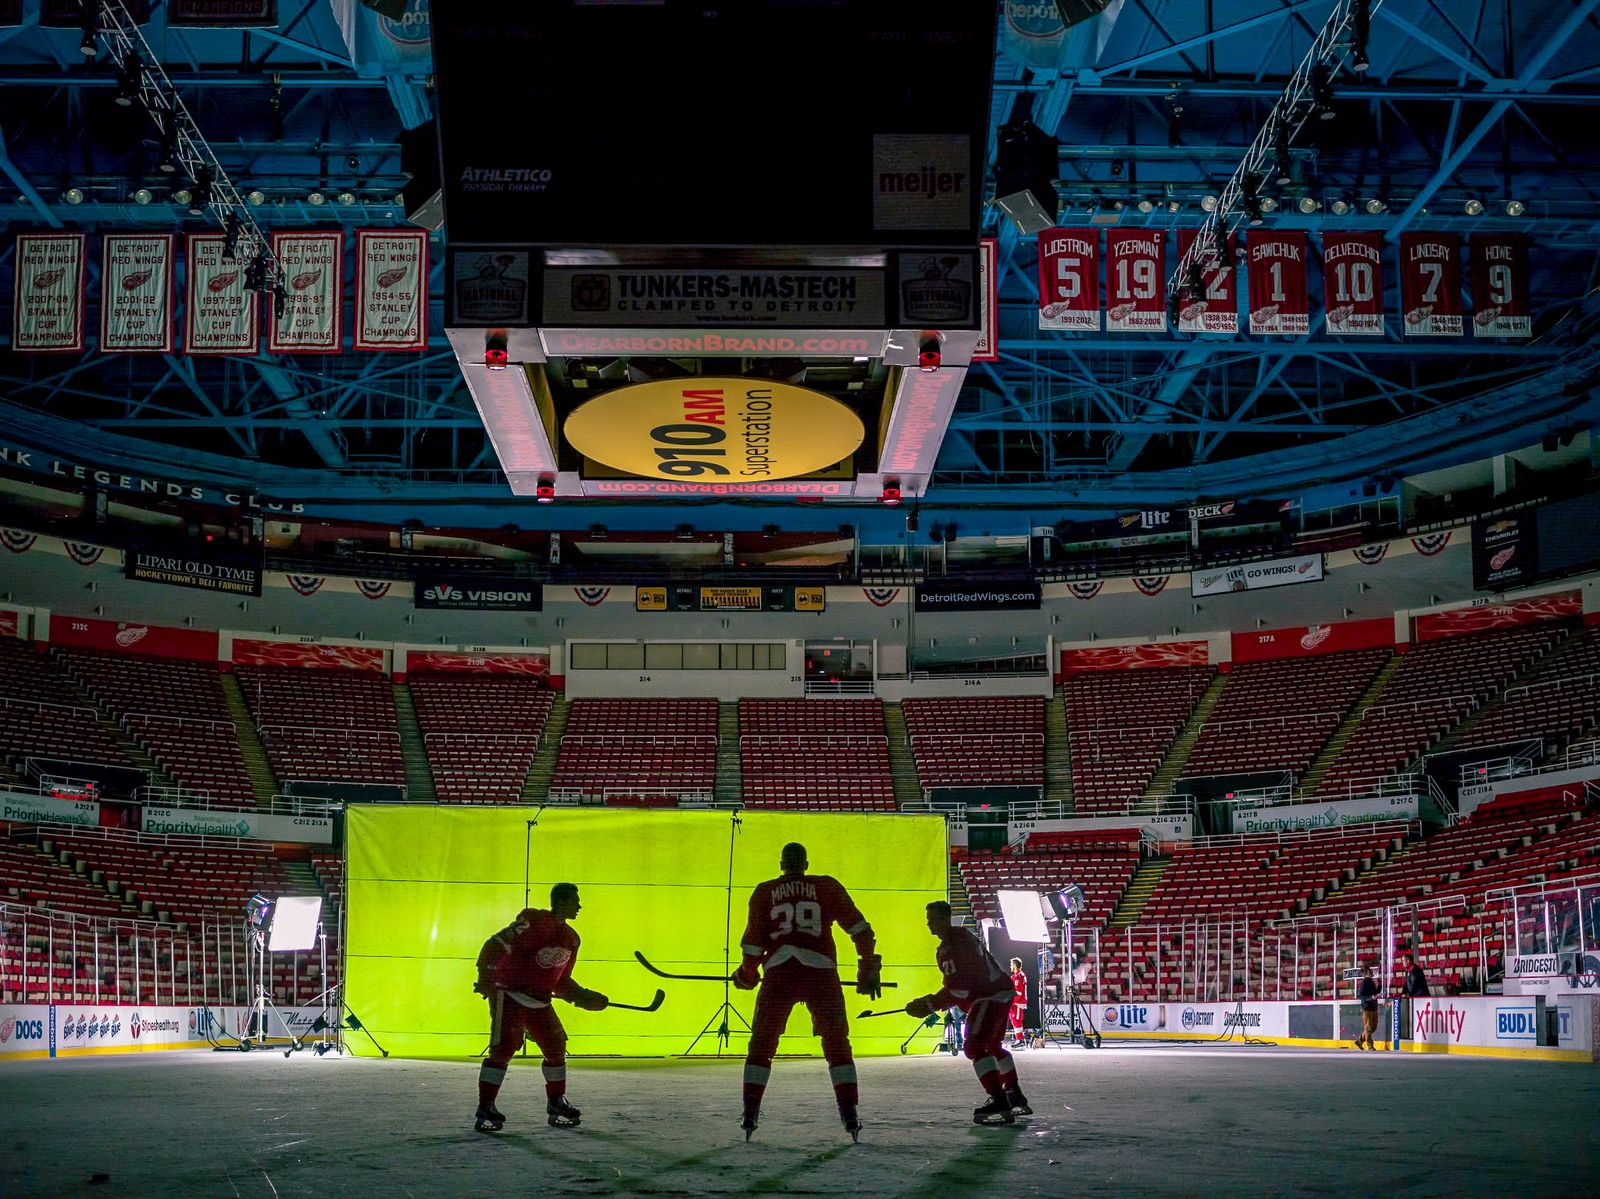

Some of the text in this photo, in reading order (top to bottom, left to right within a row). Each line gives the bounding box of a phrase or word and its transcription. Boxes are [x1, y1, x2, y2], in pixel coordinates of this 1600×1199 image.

[460, 166, 552, 182] ATHLETICO
[880, 166, 965, 199] meijer
[1154, 233, 1160, 243] C
[30, 244, 72, 253] DETROIT
[117, 244, 160, 253] DETROIT
[287, 244, 328, 253] DETROIT
[372, 242, 414, 250] DETROIT
[1044, 239, 1093, 258] LIDSTROM
[1114, 239, 1159, 259] YZERMAN
[1252, 242, 1300, 262] SAWCHUK
[25, 256, 75, 264] RED WINGS
[111, 256, 163, 265] RED WINGS
[282, 256, 333, 264] RED WINGS
[367, 253, 417, 262] RED WINGS
[1324, 242, 1380, 265] DELVECCHIO
[1410, 246, 1450, 262] LINDSAY
[1485, 245, 1513, 262] HOWE
[197, 258, 215, 266] RED
[1058, 257, 1081, 297] 5
[1116, 259, 1156, 299] 19
[1269, 262, 1286, 302] 1
[1335, 263, 1373, 302] 10
[1419, 263, 1442, 303] 7
[1489, 264, 1511, 304] 9
[618, 275, 856, 299] TUNKERS-MASTECH
[28, 295, 68, 304] 2007-08
[117, 295, 156, 304] 2001-02
[202, 296, 242, 305] 1997-98
[372, 292, 411, 300] 1954-55
[27, 307, 68, 317] STANLEY
[114, 309, 157, 317] STANLEY
[200, 308, 243, 317] STANLEY
[285, 306, 326, 315] STANLEY
[369, 304, 412, 312] STANLEY
[618, 301, 856, 313] CLAMPED TO DETROIT
[38, 320, 57, 329] CUP
[126, 321, 145, 329] CUP
[212, 321, 231, 329] CUP
[295, 319, 315, 327] CUP
[381, 316, 401, 325] CUP
[20, 332, 73, 342] CHAMPIONS
[109, 333, 162, 342] CHAMPIONS
[195, 333, 248, 342] CHAMPIONS
[278, 331, 331, 340] CHAMPIONS
[364, 328, 417, 337] CHAMPIONS
[650, 389, 729, 475] 910 AM
[738, 389, 777, 476] Superstation
[52, 460, 203, 500] LEGENDS
[1188, 505, 1221, 519] DECK
[1140, 510, 1170, 529] Lite
[136, 553, 255, 582] LIPARI OLD TYME
[1248, 569, 1262, 578] GO
[1263, 564, 1296, 576] WINGS!
[467, 591, 532, 602] VISION
[920, 591, 1035, 603] DetroitRedWings.com
[1258, 635, 1275, 643] 217A
[1246, 812, 1326, 832] PriorityHealth
[771, 881, 817, 906] MANTHA
[769, 900, 823, 941] 39
[1119, 1005, 1148, 1028] Lite
[1195, 1012, 1214, 1026] DETROIT
[1416, 1002, 1466, 1043] xfinity
[1498, 1013, 1526, 1034] BUD
[16, 1020, 43, 1040] DOCS
[64, 1022, 75, 1040] Blue
[76, 1022, 87, 1040] Blue
[88, 1022, 99, 1039] Blue
[100, 1022, 111, 1038] Blue
